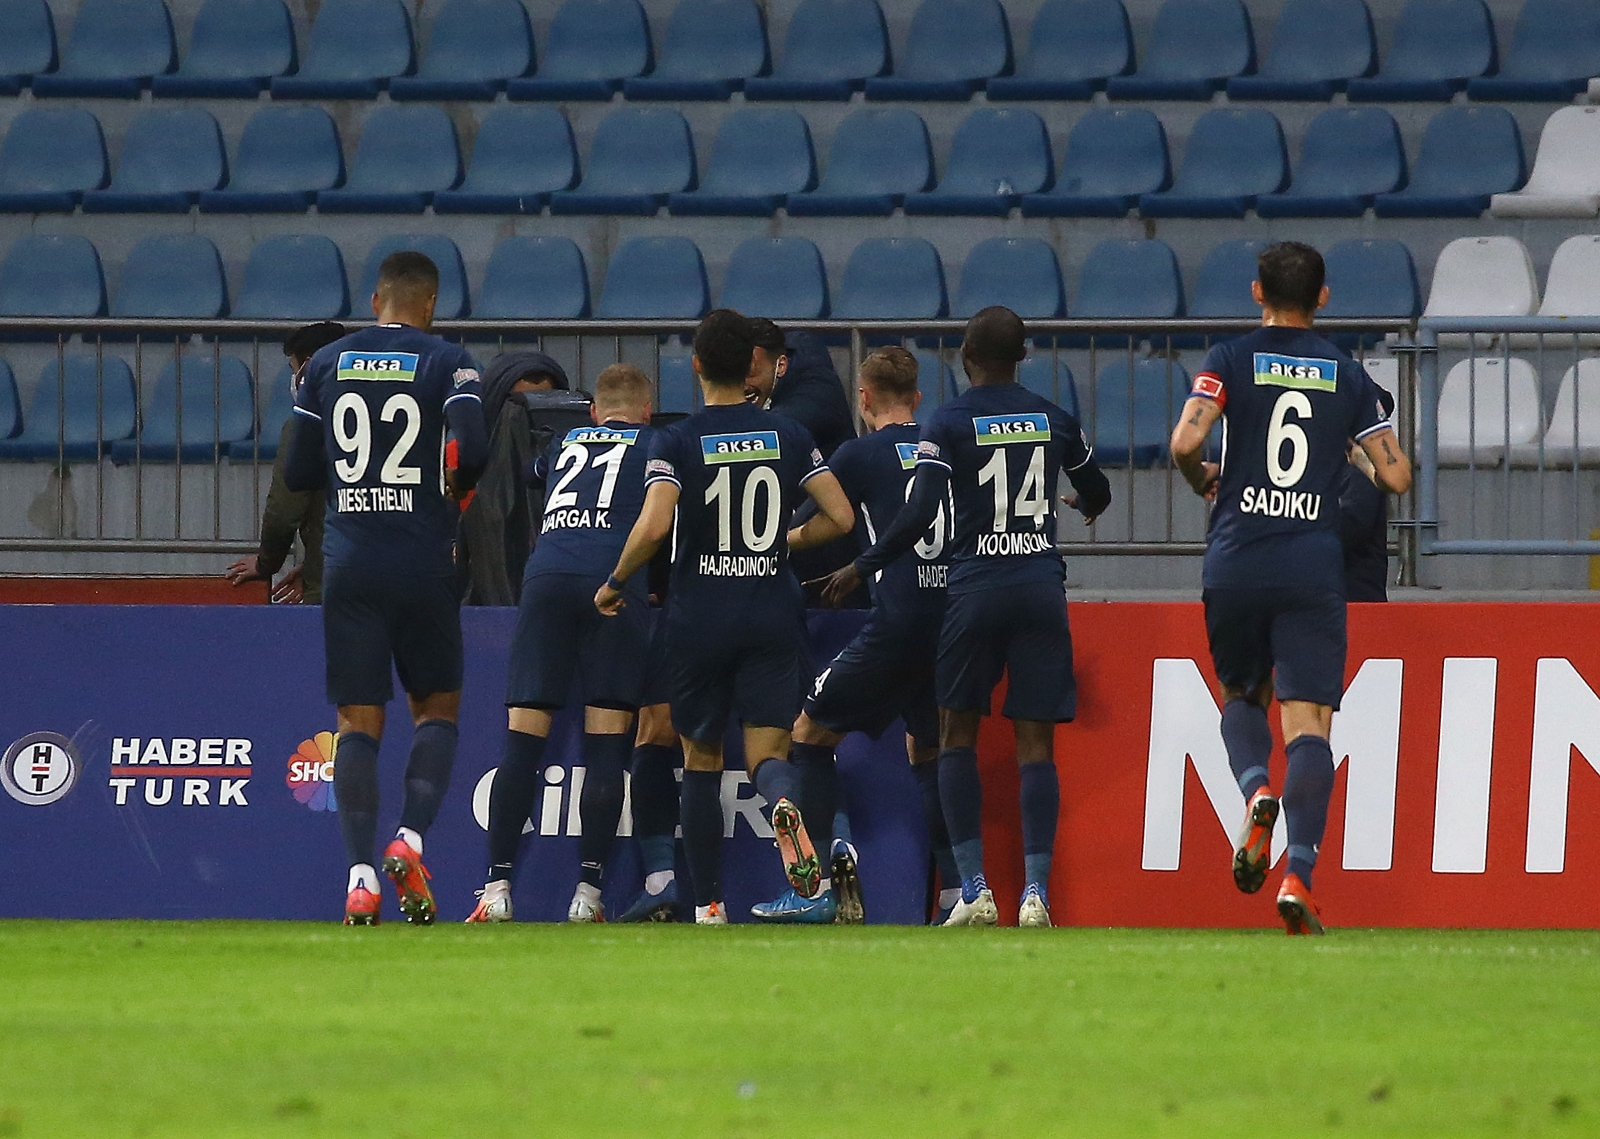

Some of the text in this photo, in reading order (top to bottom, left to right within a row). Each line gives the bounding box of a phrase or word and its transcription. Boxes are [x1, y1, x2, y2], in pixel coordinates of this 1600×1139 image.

[352, 359, 401, 372] aksa
[1270, 362, 1321, 380] aksa
[332, 392, 421, 485] 92
[576, 431, 623, 440] aksa
[989, 421, 1036, 435] aksa
[1266, 390, 1313, 488] 6
[717, 439, 765, 453] aksa
[544, 443, 627, 515] 21
[978, 446, 1049, 532] 14
[370, 486, 413, 513] THELIN
[705, 466, 781, 552] 10
[1240, 486, 1321, 521] SADIKU
[541, 509, 612, 535] VARGA K.
[976, 532, 1054, 556] KOOMSON
[111, 738, 252, 765] HABER
[109, 778, 250, 806] TURK
